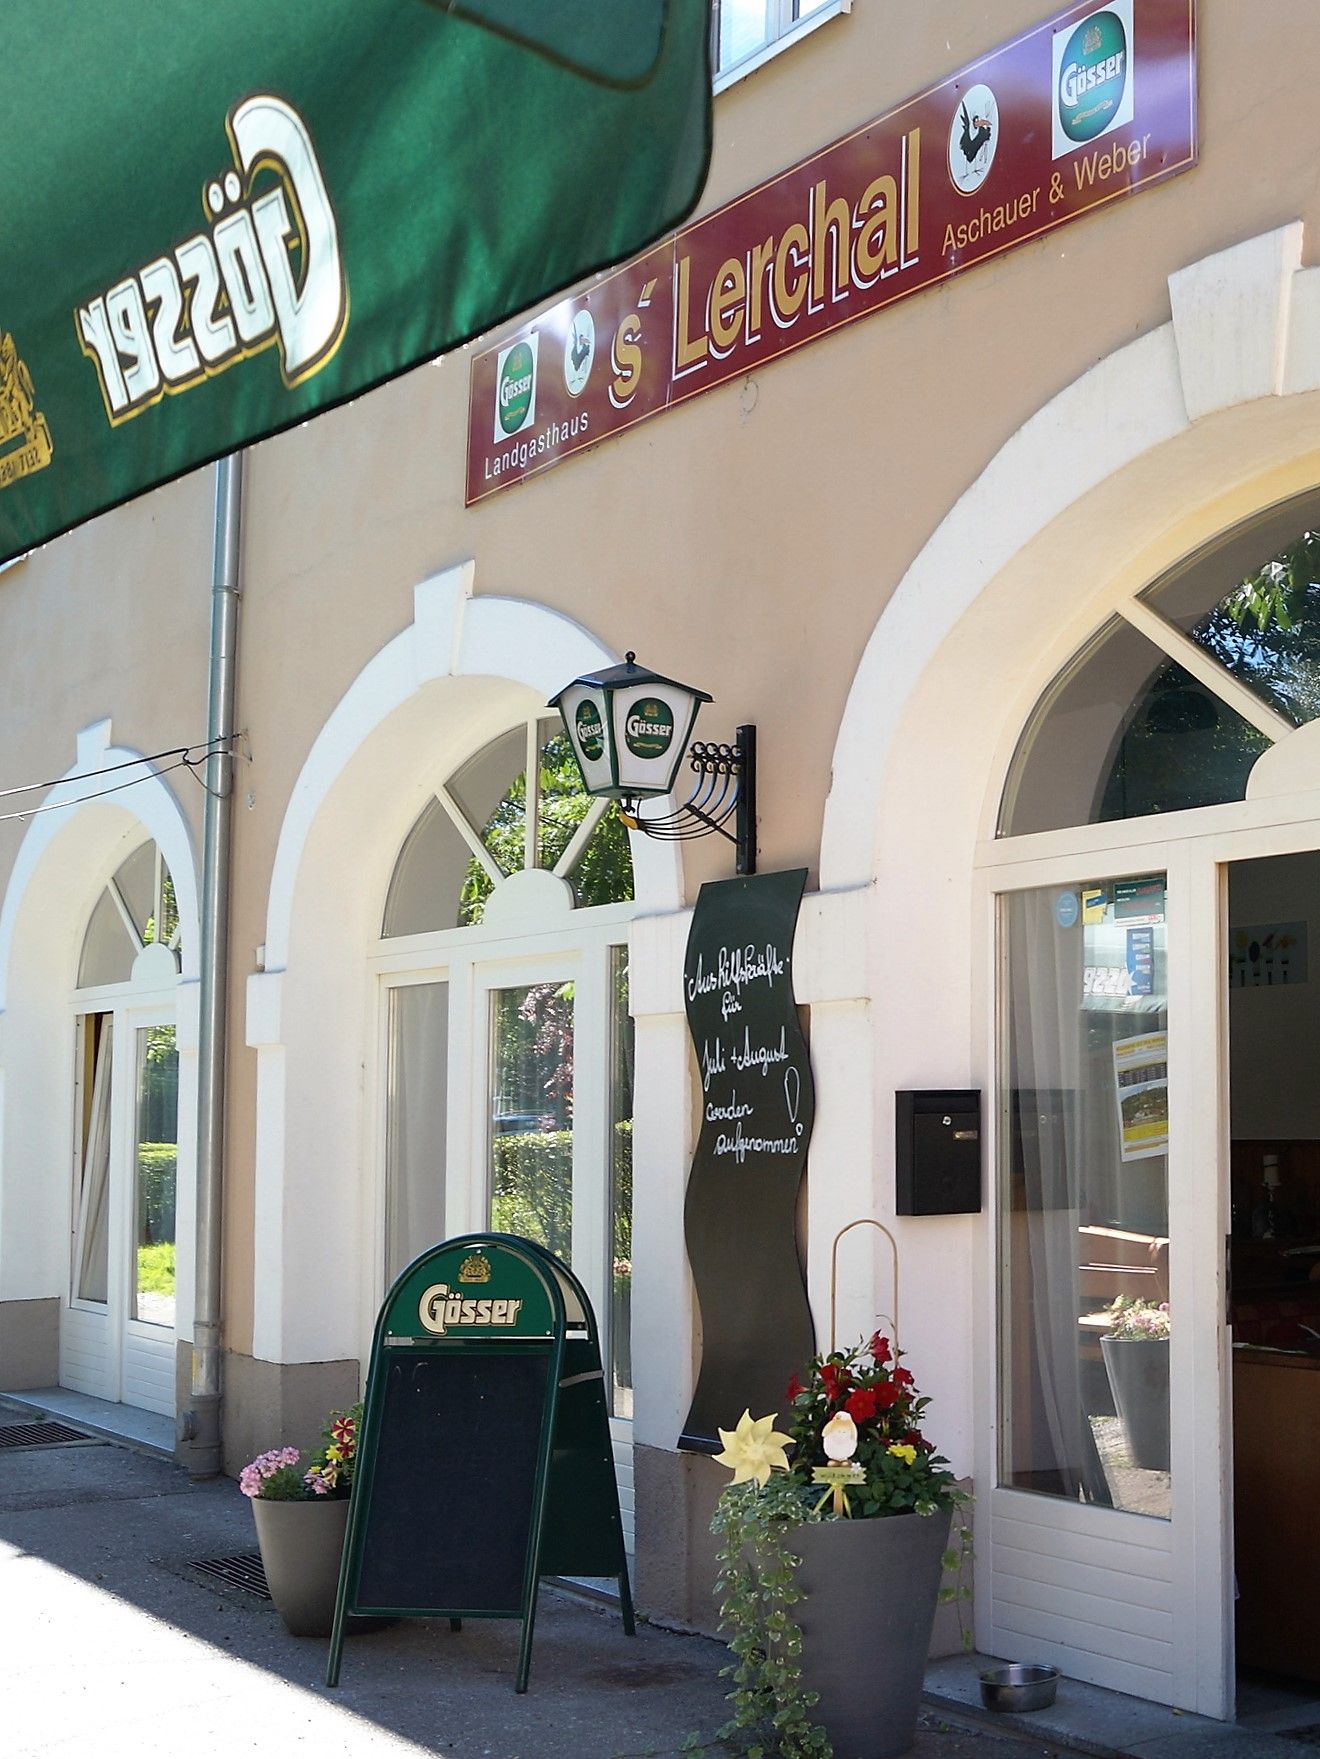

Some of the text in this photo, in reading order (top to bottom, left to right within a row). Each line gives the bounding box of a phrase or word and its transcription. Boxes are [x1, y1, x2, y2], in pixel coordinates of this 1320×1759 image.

[1060, 50, 1124, 108] Gösser
[941, 132, 1151, 257] Aschauer & Weber
[672, 127, 921, 381] Lerchal
[499, 373, 533, 407] Gösser
[484, 411, 589, 480] Landgasthaus
[577, 720, 602, 743] Gösser
[627, 714, 672, 738] Gösser
[721, 991, 743, 1022] für
[702, 1036, 726, 1092] Juli
[736, 1025, 789, 1077] August
[418, 1283, 522, 1336] Gösser
